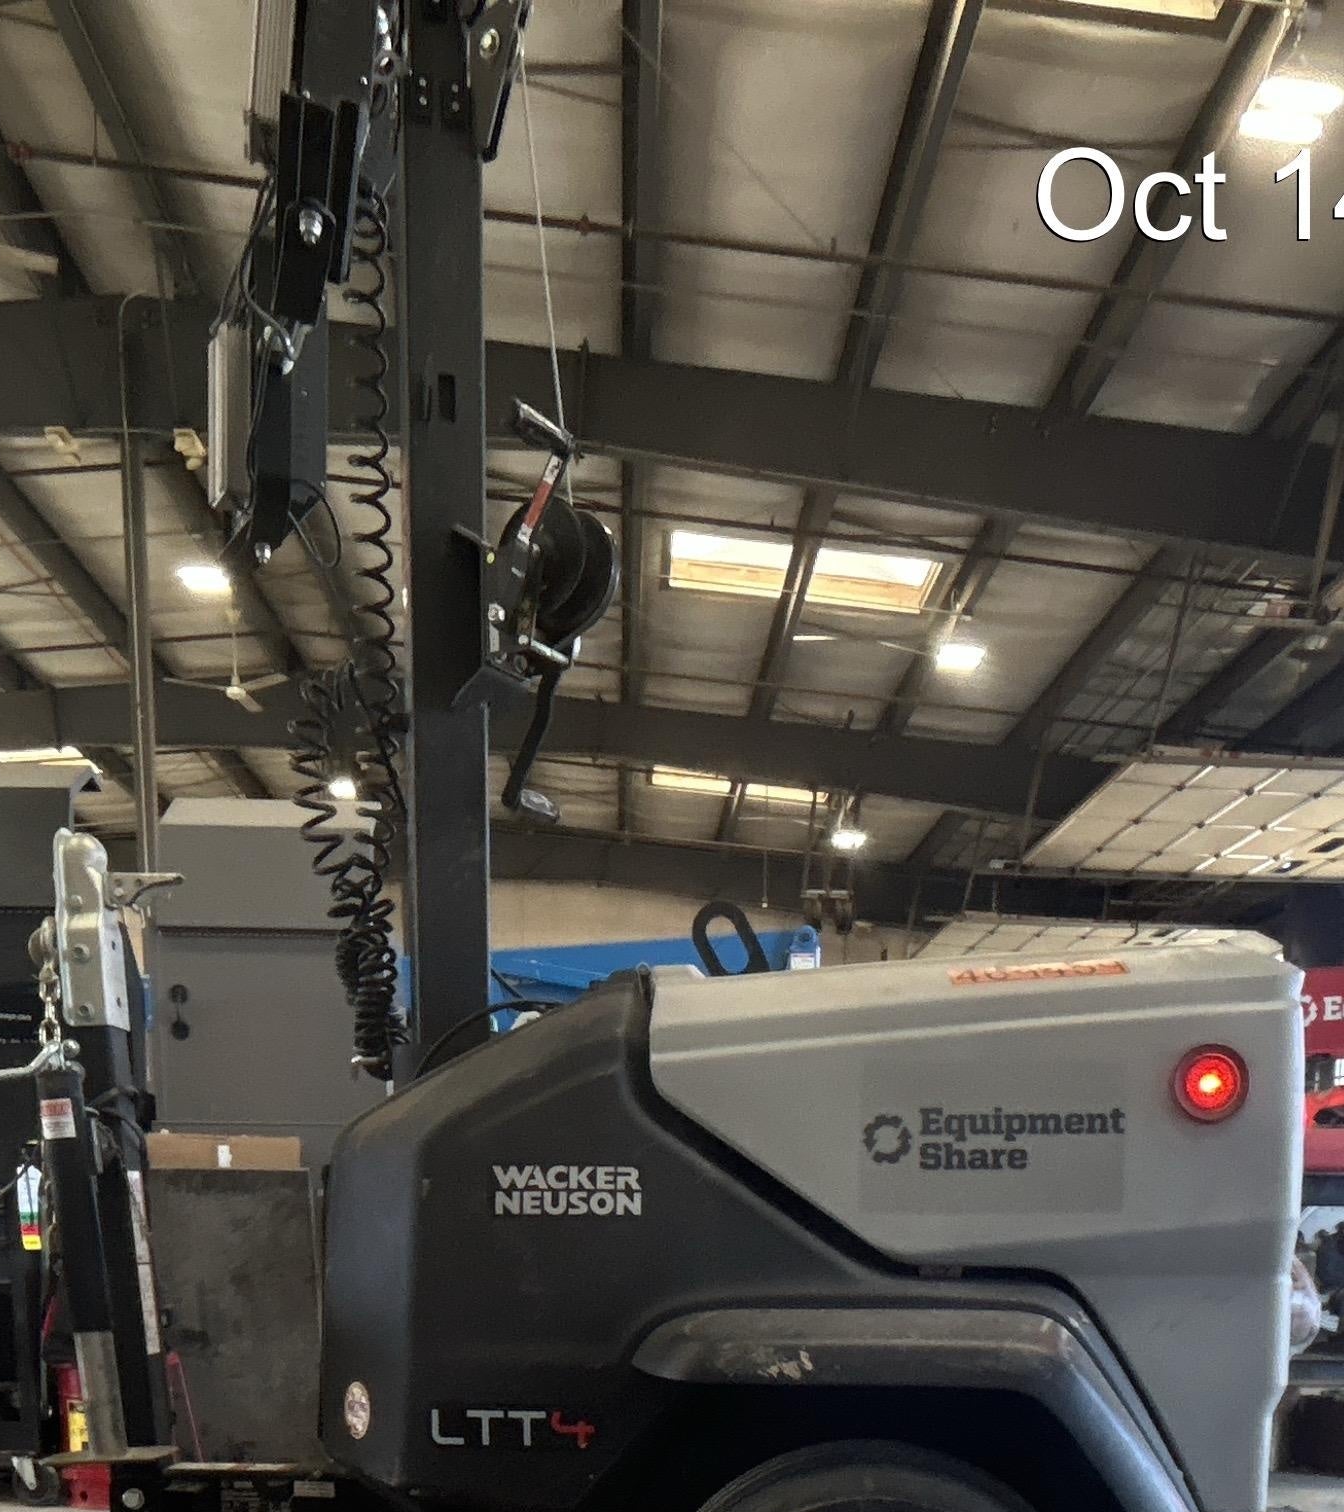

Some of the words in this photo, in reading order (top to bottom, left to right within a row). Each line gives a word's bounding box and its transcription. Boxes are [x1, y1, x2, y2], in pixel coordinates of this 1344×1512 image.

[918, 1106, 1126, 1142] Equipment
[918, 1142, 1029, 1171] Share
[492, 1164, 643, 1191] WACKER
[494, 1190, 643, 1216] NEUSON
[430, 1408, 596, 1449] LTT4
